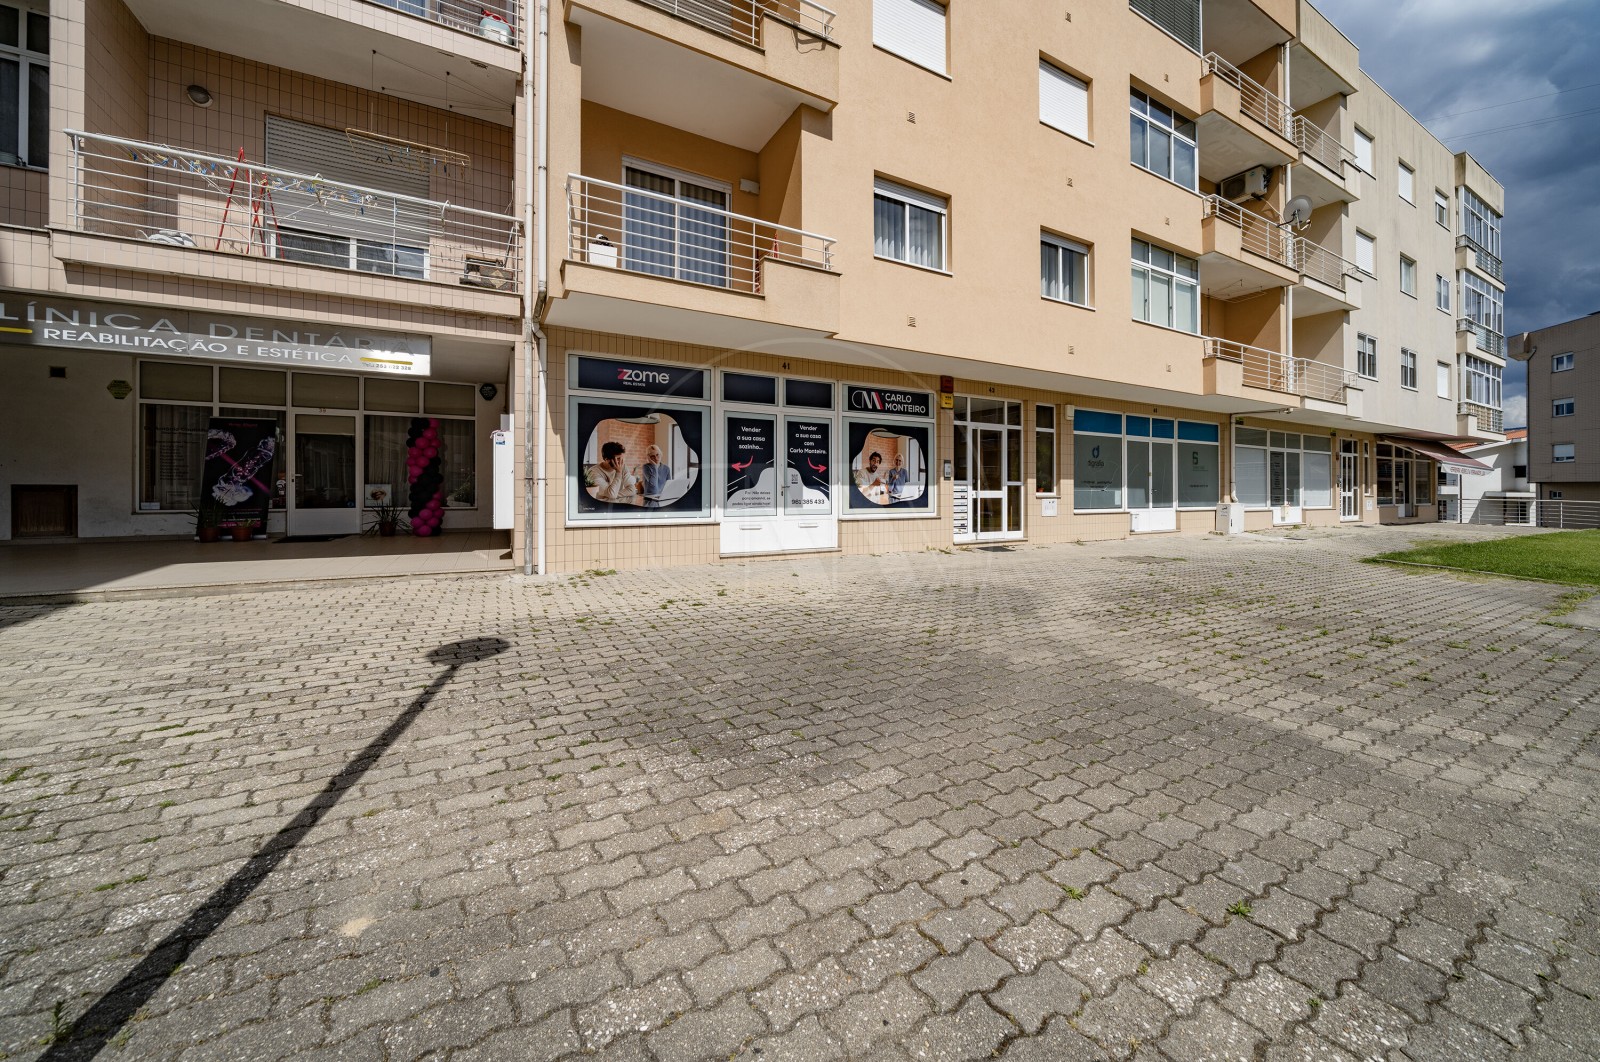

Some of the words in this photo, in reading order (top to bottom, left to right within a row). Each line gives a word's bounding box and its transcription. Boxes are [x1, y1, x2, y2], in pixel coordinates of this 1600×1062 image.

[209, 322, 414, 356] DENTÁRIA
[43, 328, 227, 352] REABILITAÇÃO
[237, 345, 248, 355] E
[257, 346, 352, 363] ESTÉTICA
[782, 362, 790, 370] 41
[885, 393, 912, 403] CARLO
[885, 403, 926, 413] MONTEIRO
